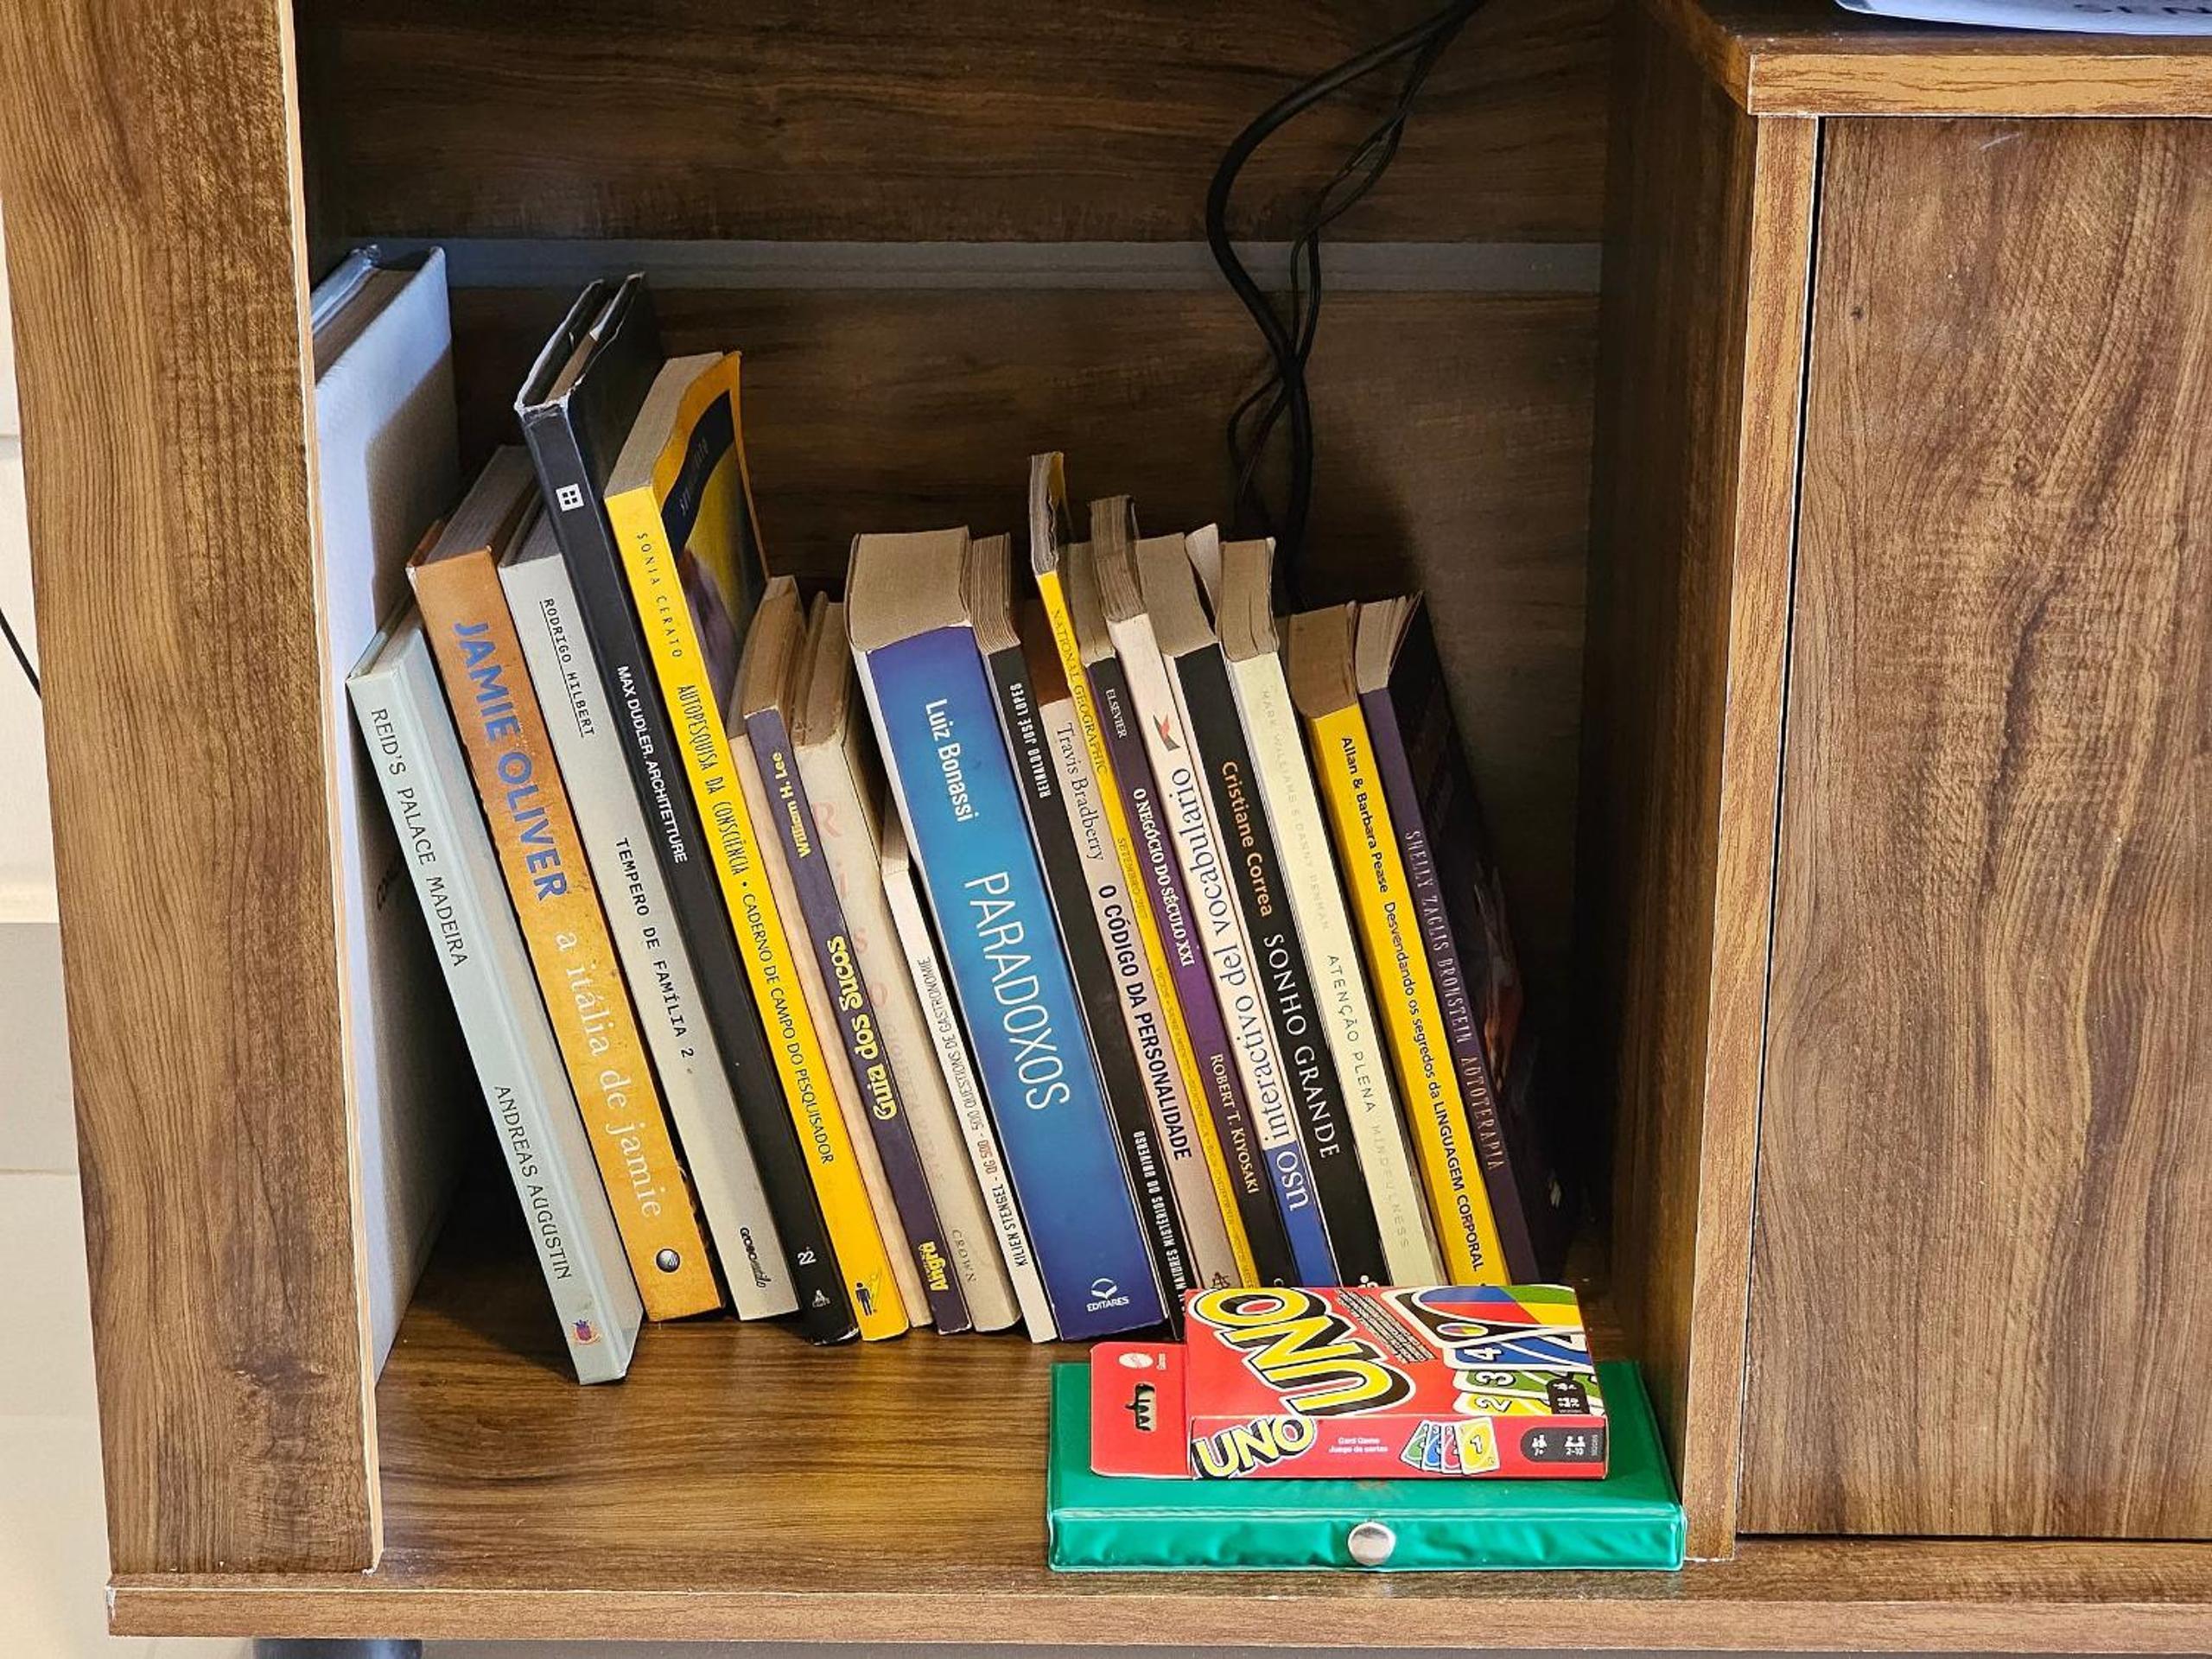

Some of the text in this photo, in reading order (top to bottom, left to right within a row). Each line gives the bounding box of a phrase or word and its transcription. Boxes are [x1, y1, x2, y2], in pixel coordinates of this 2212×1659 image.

[637, 531, 683, 658] SONIA CERATO
[544, 598, 594, 736] RODRIGO HILBERT
[1009, 683, 1027, 717] LOPES
[1052, 609, 1108, 774] NATIONAL GEOGRAPHIC
[1105, 689, 1128, 739] ELSEVIER
[454, 621, 569, 900] JAMIE OLIVER
[617, 665, 688, 863] MAX DUDLER. ARCHITETTURE
[772, 752, 788, 780] Lee
[925, 699, 979, 822] Luiz Bonassi
[1027, 747, 1052, 798] REINALDO
[1057, 722, 1103, 861] Travis Bradberry
[372, 708, 468, 967] REID'S PALACE MADEIRA
[788, 802, 811, 859] William
[1170, 767, 1230, 936] vocabulario
[1222, 761, 1273, 917] Cristiane Correa
[1341, 737, 1388, 893] Allan & Barbara Pease
[677, 683, 834, 1164] AUTOPESQUISA DA CONSCIÊNCIA CADERNO DE CAMPO DO PESQUISADOR
[1133, 788, 1195, 967] O NEGÓCIO DO SÉCULO XXI
[615, 837, 694, 1059] TEMPERO DE FAMÍLIA 2
[1213, 944, 1247, 986] del
[1404, 830, 1472, 1044] SHELLY ZAGLIS BRONSTEIN
[827, 936, 897, 1121] Guia dos Sucos
[917, 955, 951, 1033] GASTRONOMIE
[964, 871, 1071, 1110] PARADOXOS
[1098, 885, 1192, 1160] O CÓDIGO DA PERSONALIDADE
[1328, 955, 1376, 1113] ATENÇÃO PLENA
[555, 932, 662, 1217] a itália de jamie
[942, 1033, 957, 1050] DE
[949, 1049, 978, 1109] QUESTIONS
[1211, 1054, 1233, 1108] ROBERT
[1236, 995, 1288, 1141] interactivo
[1264, 933, 1340, 1159] SONHO GRANDE
[1383, 902, 1484, 1272] Desvendando os segredos da LINGUAGEM CORPORAL
[979, 1139, 994, 1160] 500
[1133, 1130, 1154, 1179] UNIVERSO
[1227, 1112, 1241, 1126] T.
[1232, 1128, 1259, 1194] KIYOSAKI
[1460, 1056, 1503, 1171] AUTOTERAPIA
[494, 1085, 573, 1280] ANDREAS AUGUSTIN
[991, 1182, 1016, 1230] STENGEL
[1152, 1196, 1175, 1247] MISTÉRIOS
[797, 1250, 817, 1266] 22
[952, 1229, 976, 1282] CROWN
[1005, 1231, 1028, 1267] KILIEN
[1166, 1249, 1187, 1290] MAIORES
[1086, 1296, 1129, 1312] EDITARES
[1186, 1285, 1414, 1415] UNO
[1465, 1347, 1503, 1362] 4
[1474, 1371, 1516, 1387] 3
[1192, 1416, 1317, 1479] UNO
[1470, 1433, 1484, 1455] 1
[1474, 1395, 1512, 1413] 2
